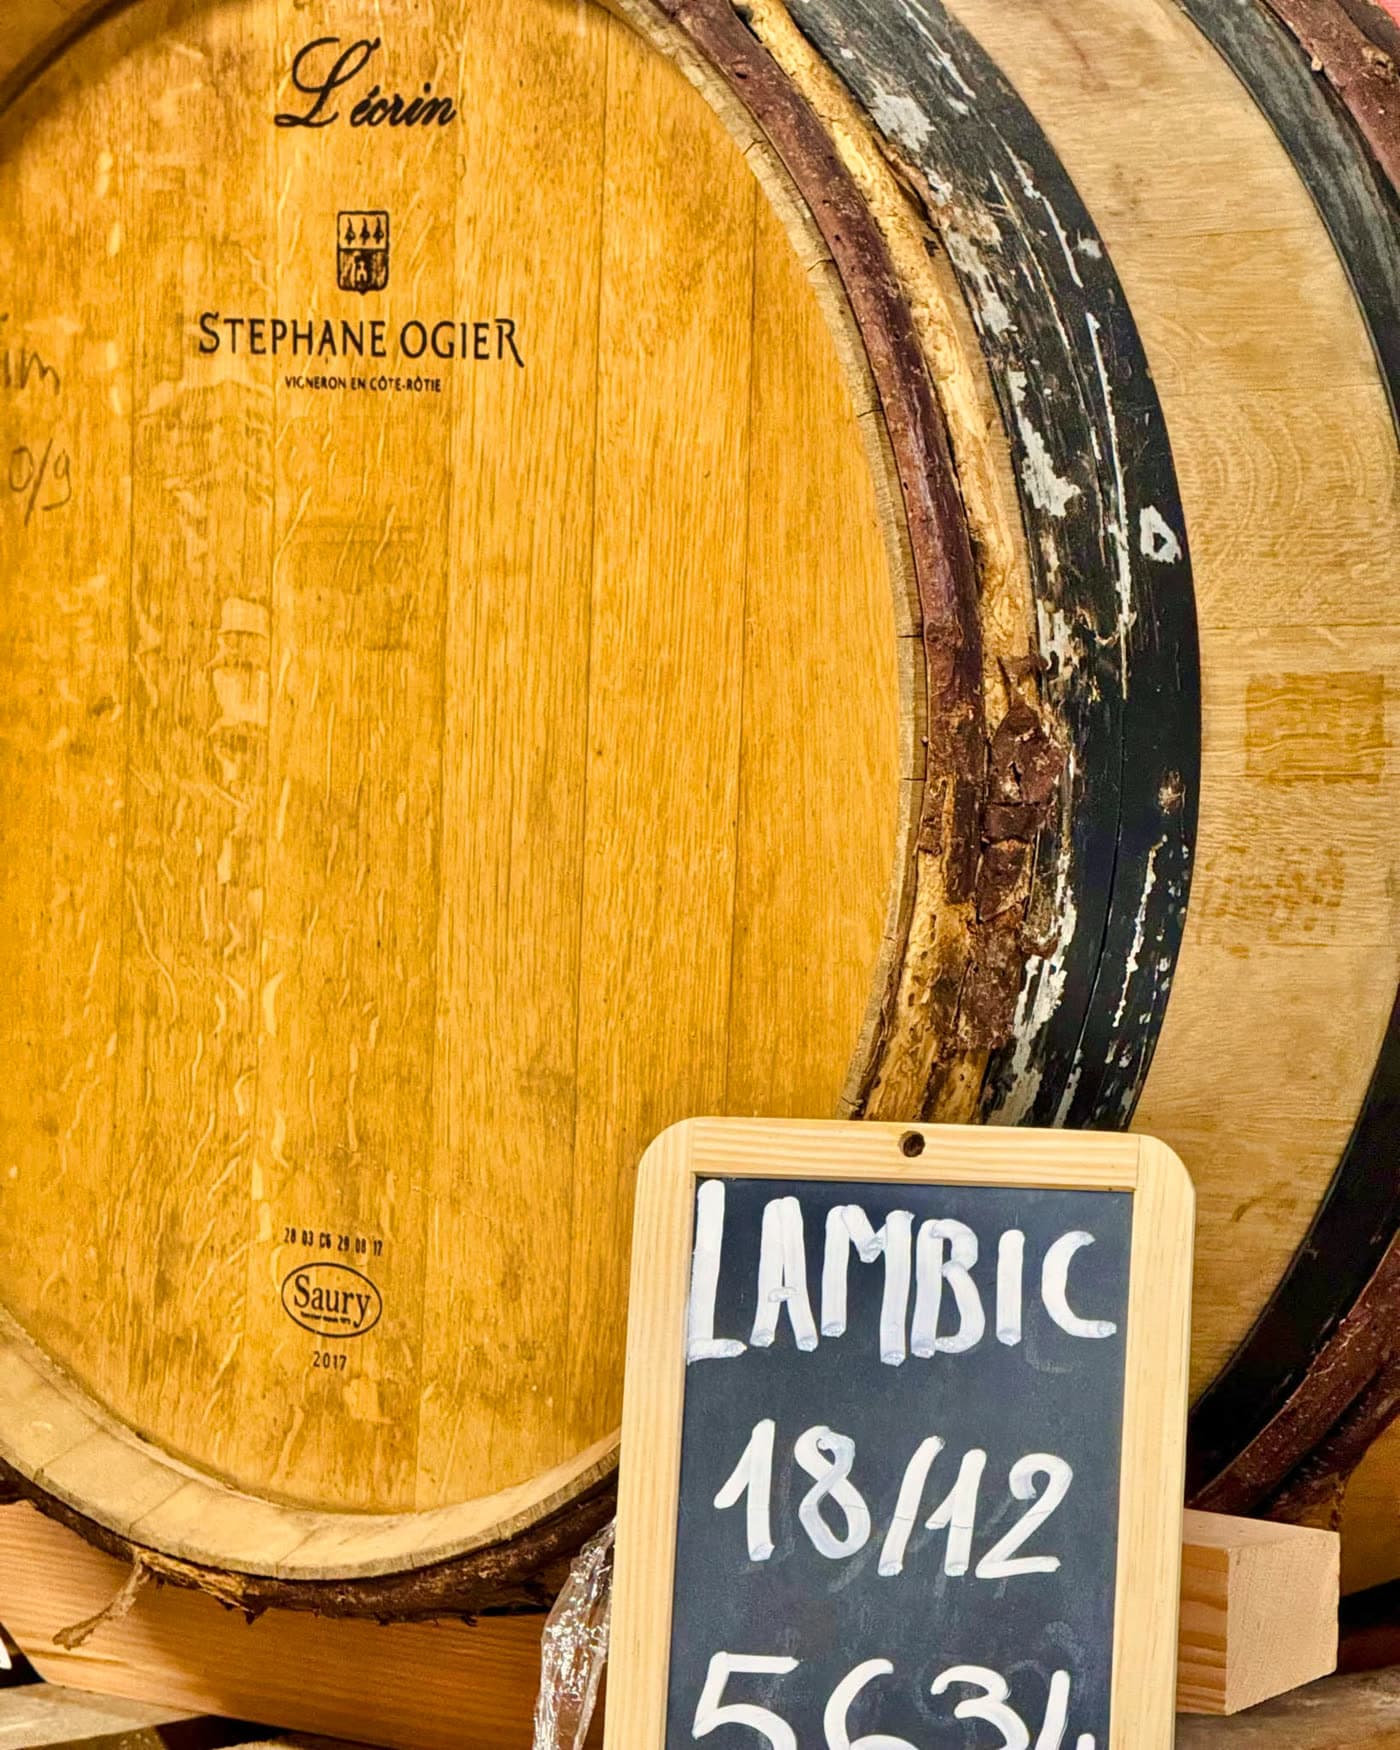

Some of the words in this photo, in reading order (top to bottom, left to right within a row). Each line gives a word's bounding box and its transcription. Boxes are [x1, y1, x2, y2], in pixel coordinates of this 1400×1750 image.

[198, 310, 387, 358] STEPHANE
[399, 317, 525, 368] OGIER
[284, 375, 347, 390] VIGNERON
[350, 376, 367, 391] EN
[369, 375, 442, 393] CÔTE-RÔTIE
[293, 1273, 372, 1329] Saury
[686, 1179, 1118, 1367] LAMBIC
[312, 1350, 348, 1372] 2017
[712, 1418, 1074, 1579] 18/12
